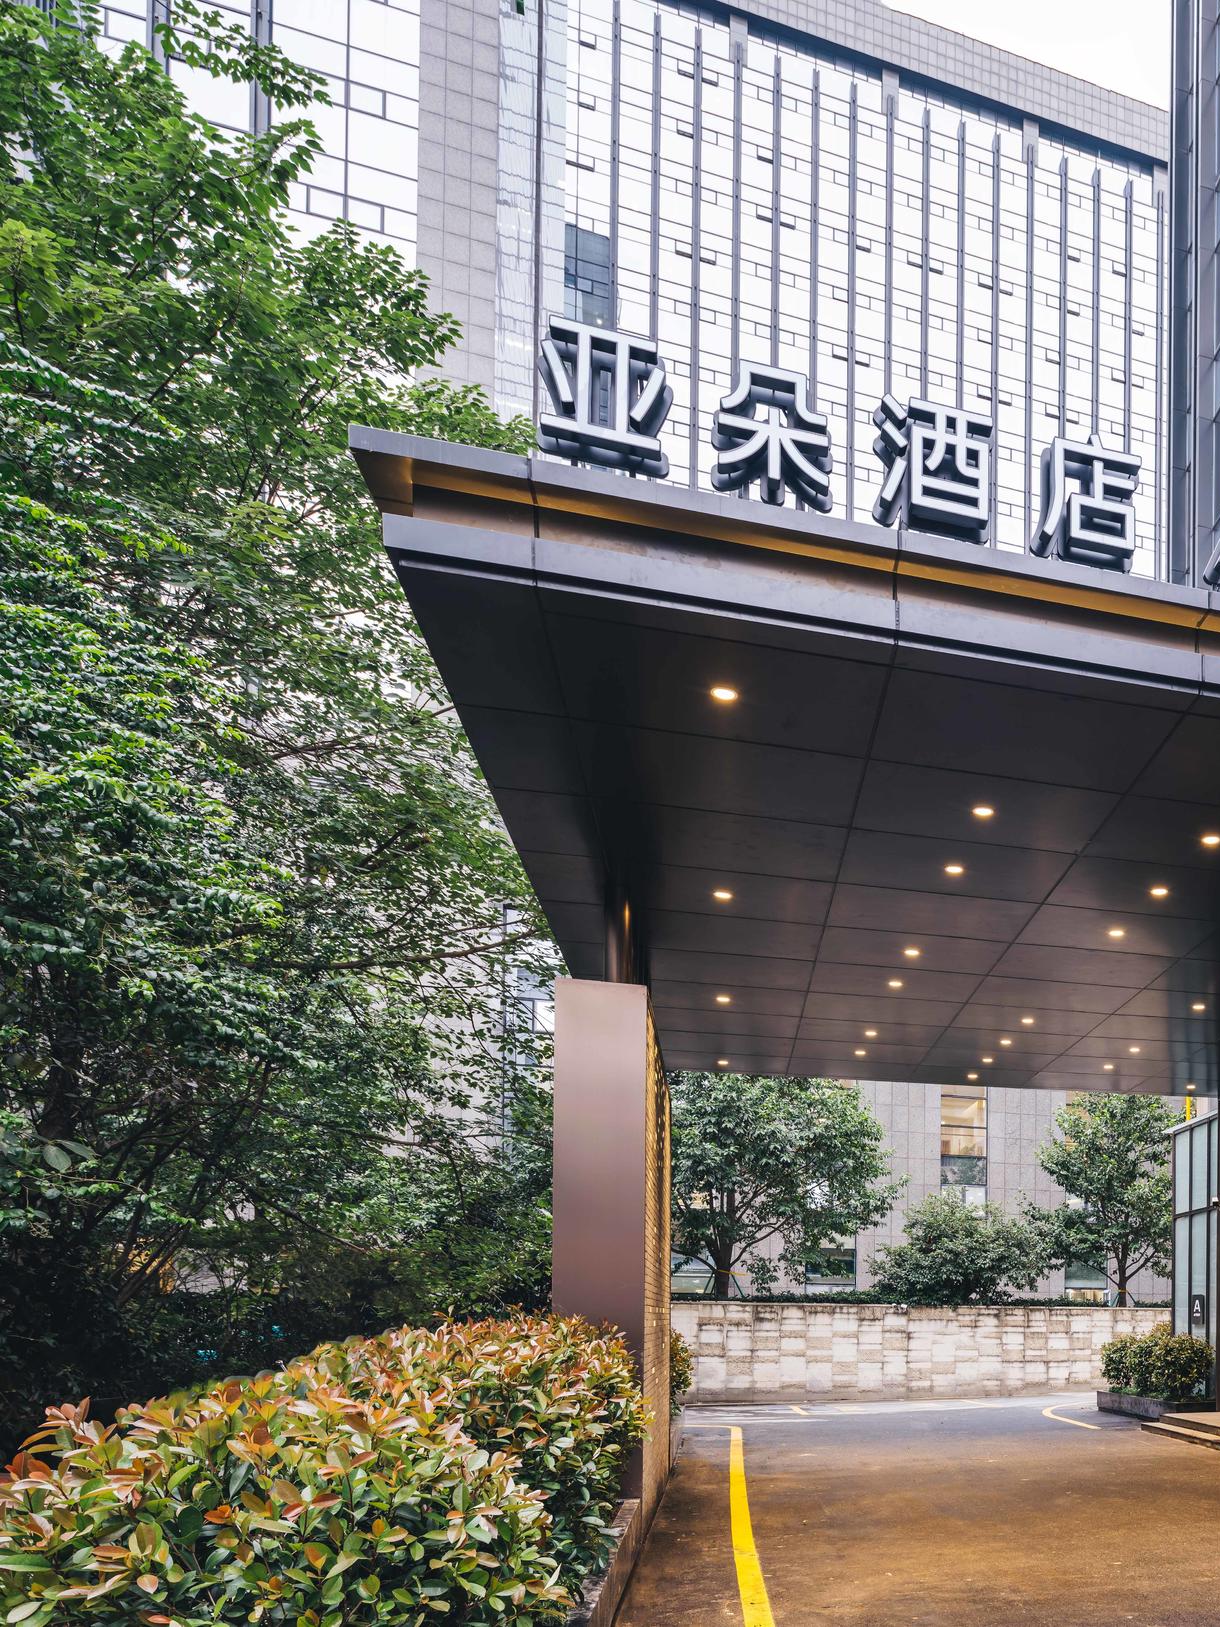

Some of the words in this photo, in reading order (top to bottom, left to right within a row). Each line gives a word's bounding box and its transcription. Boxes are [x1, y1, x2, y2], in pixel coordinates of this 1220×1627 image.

[537, 314, 1143, 572] 亚朵酒店
[1193, 1299, 1201, 1312] A
